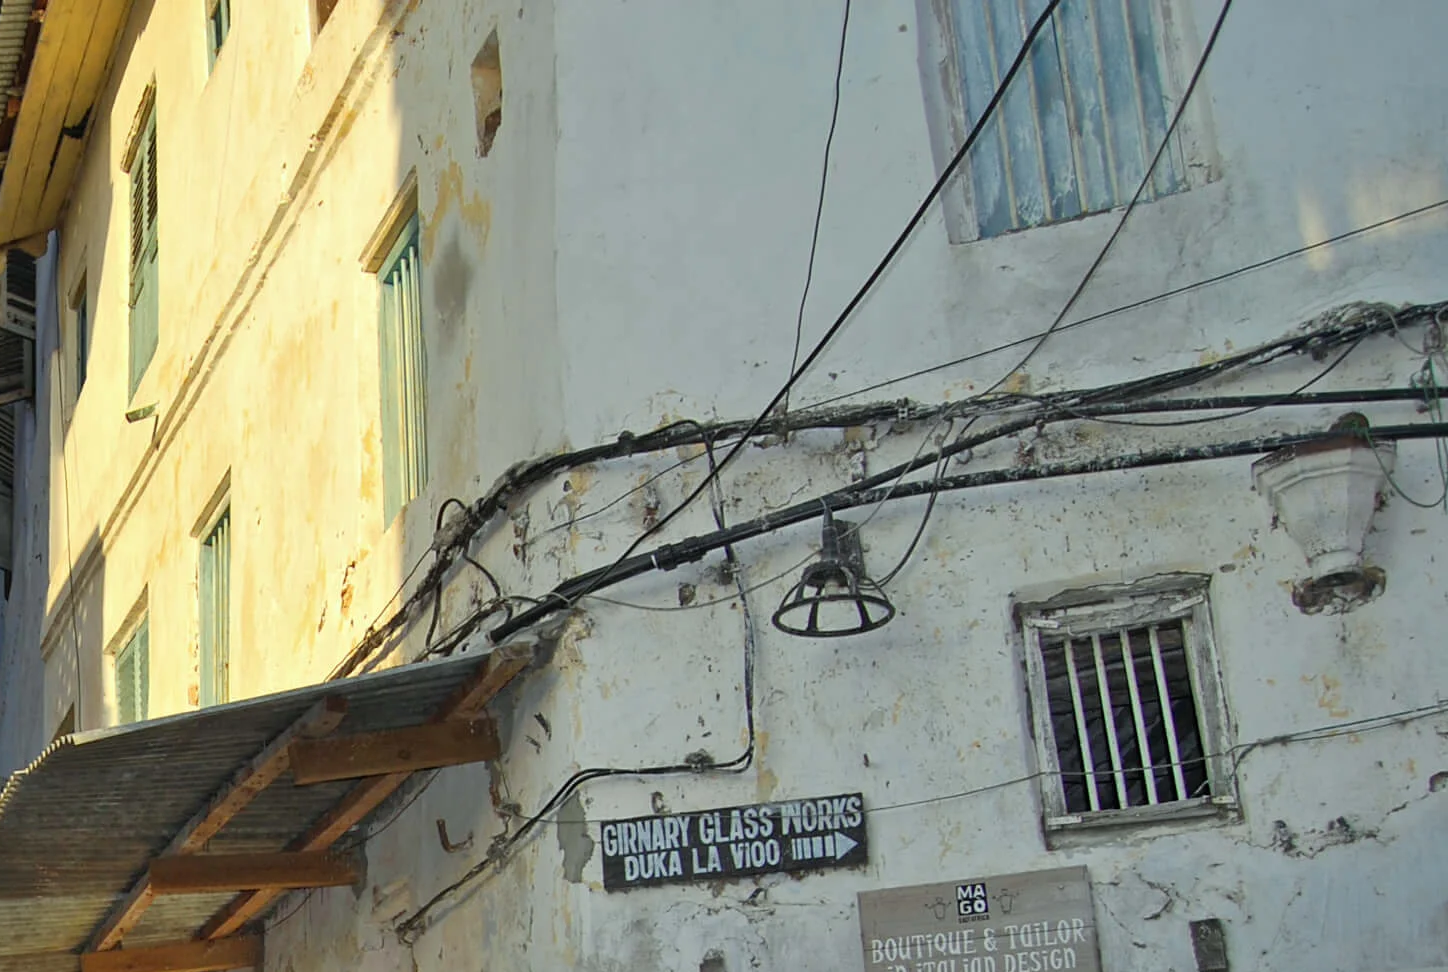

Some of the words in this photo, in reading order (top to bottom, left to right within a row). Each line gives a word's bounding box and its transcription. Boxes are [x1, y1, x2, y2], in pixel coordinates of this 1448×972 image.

[603, 815, 691, 857] GIRNARY
[699, 807, 774, 845] GLASS
[781, 796, 862, 836] WORKS
[624, 850, 683, 881] DUKA
[692, 846, 722, 874] LA
[957, 884, 985, 900] MA
[983, 928, 998, 952] &
